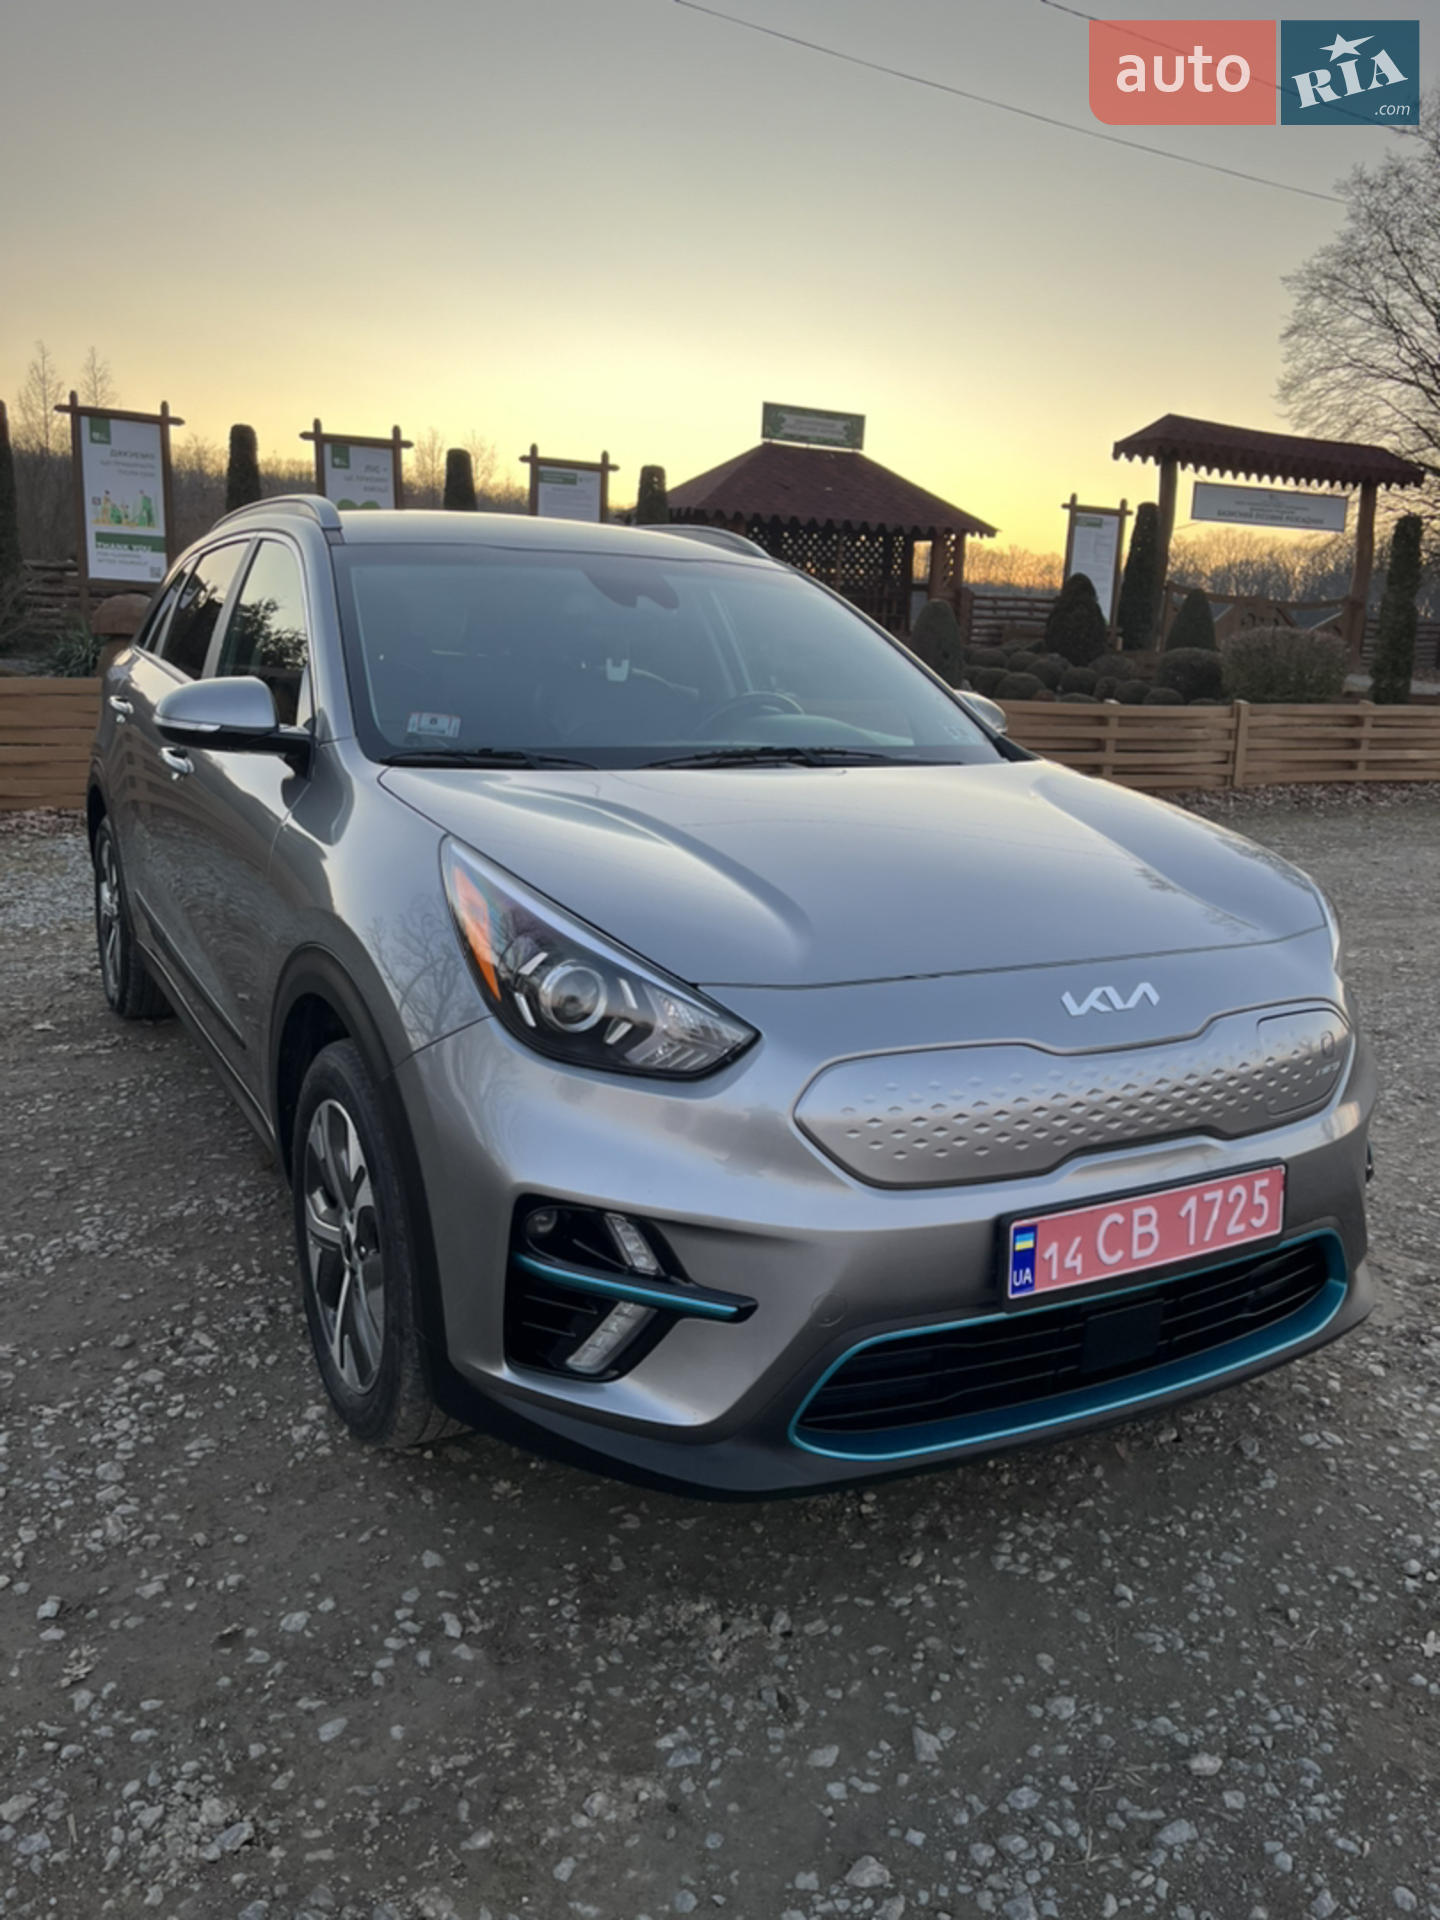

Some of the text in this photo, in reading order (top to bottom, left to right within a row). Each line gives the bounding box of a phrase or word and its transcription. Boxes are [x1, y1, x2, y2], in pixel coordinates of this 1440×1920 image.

[1061, 982, 1160, 1017] KIA
[1042, 1236, 1083, 1281] 14
[1178, 1178, 1270, 1246] 1725
[1013, 1267, 1032, 1287] UA
